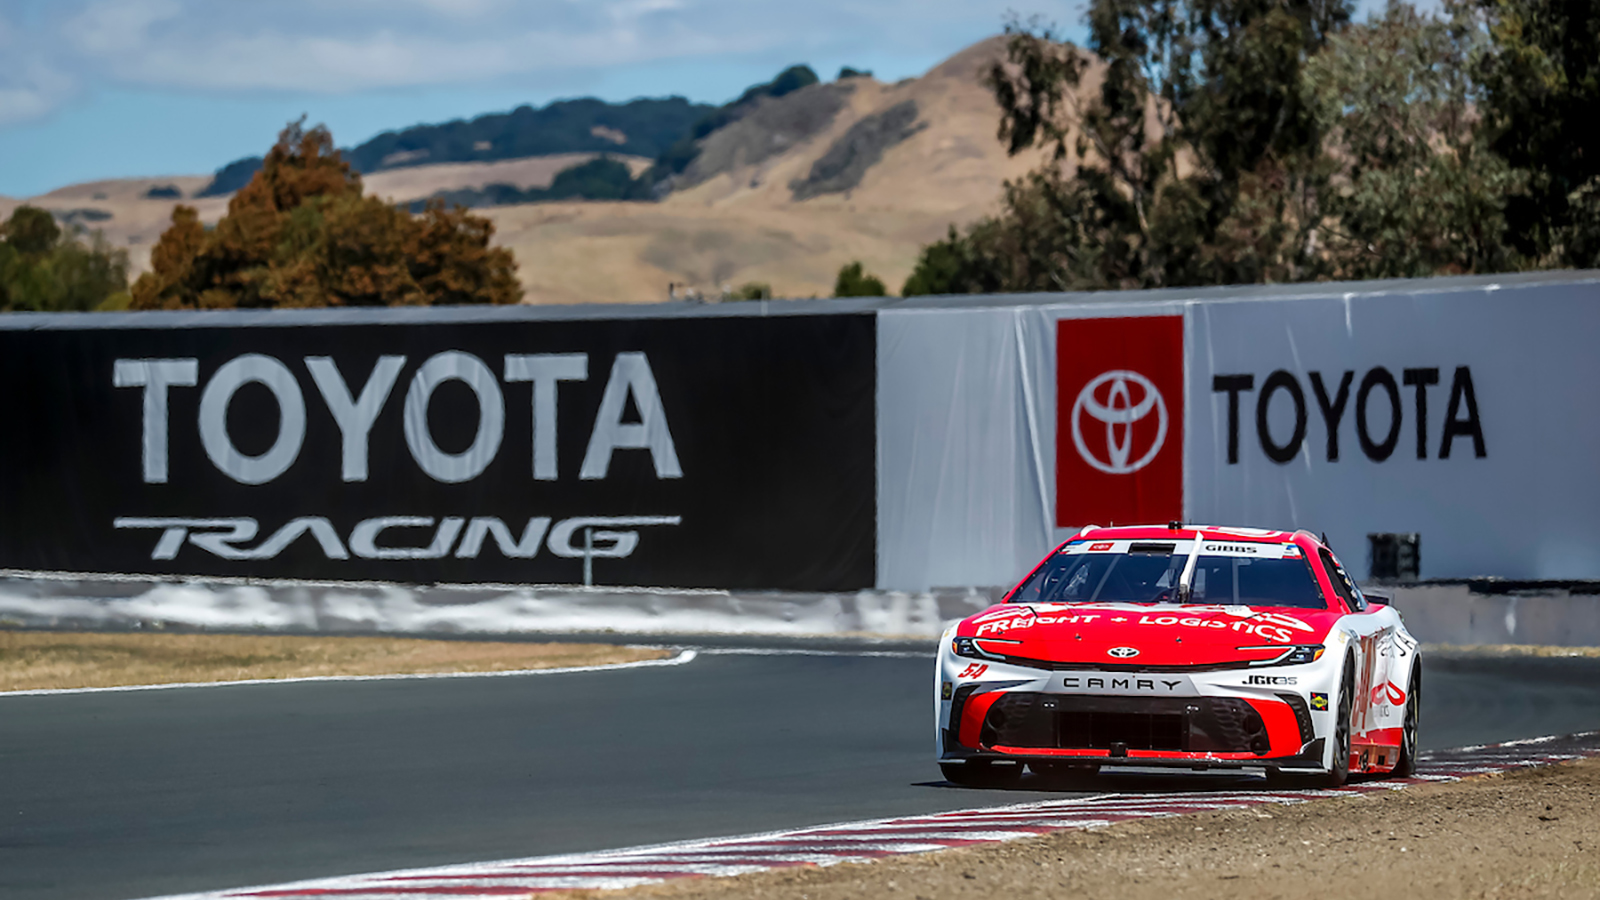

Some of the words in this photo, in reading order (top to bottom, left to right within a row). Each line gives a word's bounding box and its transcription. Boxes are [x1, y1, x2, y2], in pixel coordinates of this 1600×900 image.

[113, 350, 684, 485] TOYOTA
[1212, 365, 1487, 465] TOYOTA
[113, 516, 682, 560] RACING
[1205, 543, 1257, 554] GIBBS
[975, 614, 1101, 637] FREIGHT
[1138, 615, 1293, 643] LOGISTICS
[957, 662, 990, 680] 54
[1063, 677, 1182, 691] CAMRY
